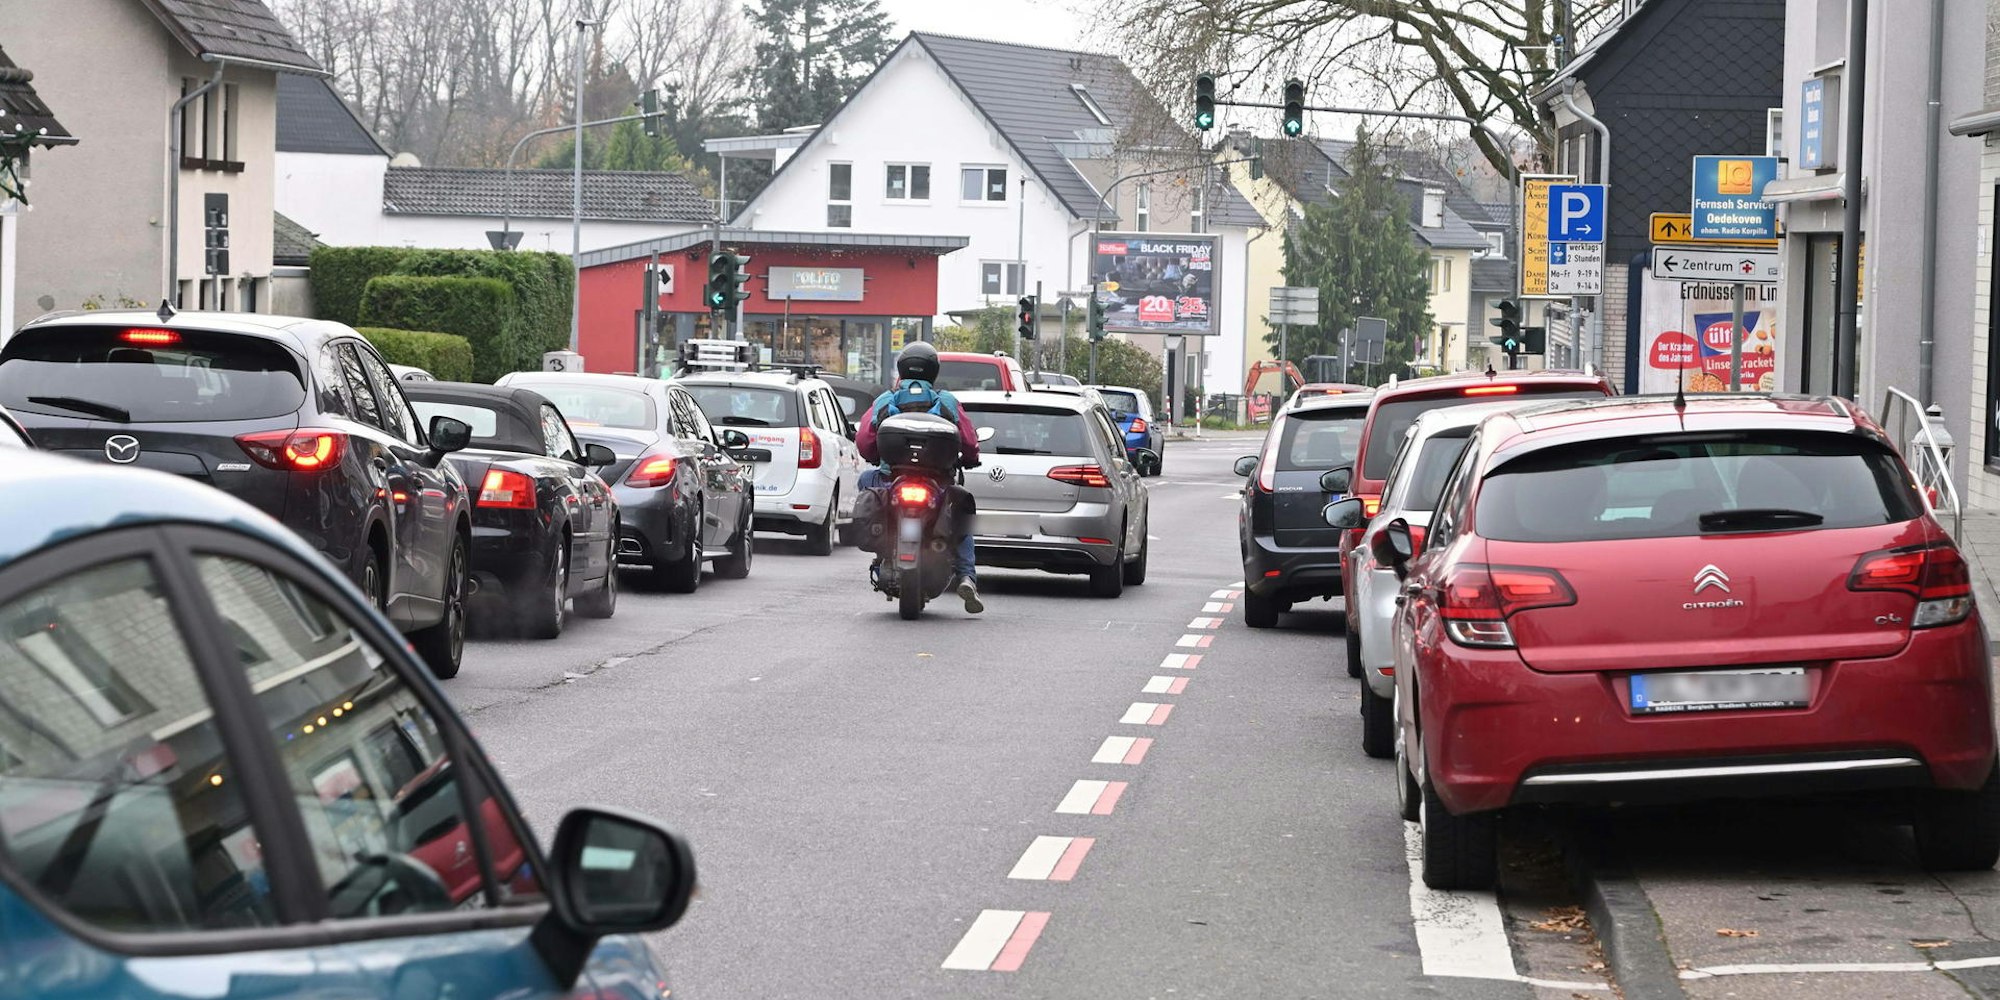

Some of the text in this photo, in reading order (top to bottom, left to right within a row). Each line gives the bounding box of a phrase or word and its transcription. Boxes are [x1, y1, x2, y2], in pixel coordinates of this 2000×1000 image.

[1560, 191, 1591, 235] P
[1706, 213, 1762, 224] Oedekoven
[1721, 227, 1740, 235] Radio
[1140, 243, 1212, 255] BLACK FRIDAY
[1567, 255, 1600, 263] 2 Stunden
[1682, 258, 1733, 272] Zentrum
[1550, 269, 1600, 278] Mo-Fr 9-19 h
[1550, 282, 1600, 290] Sa 9-14 h
[1744, 286, 1756, 300] m
[1741, 356, 1774, 369] racket
[753, 484, 778, 492] nik.de
[1682, 598, 1744, 610] CITROËN
[1874, 613, 1903, 625] C4
